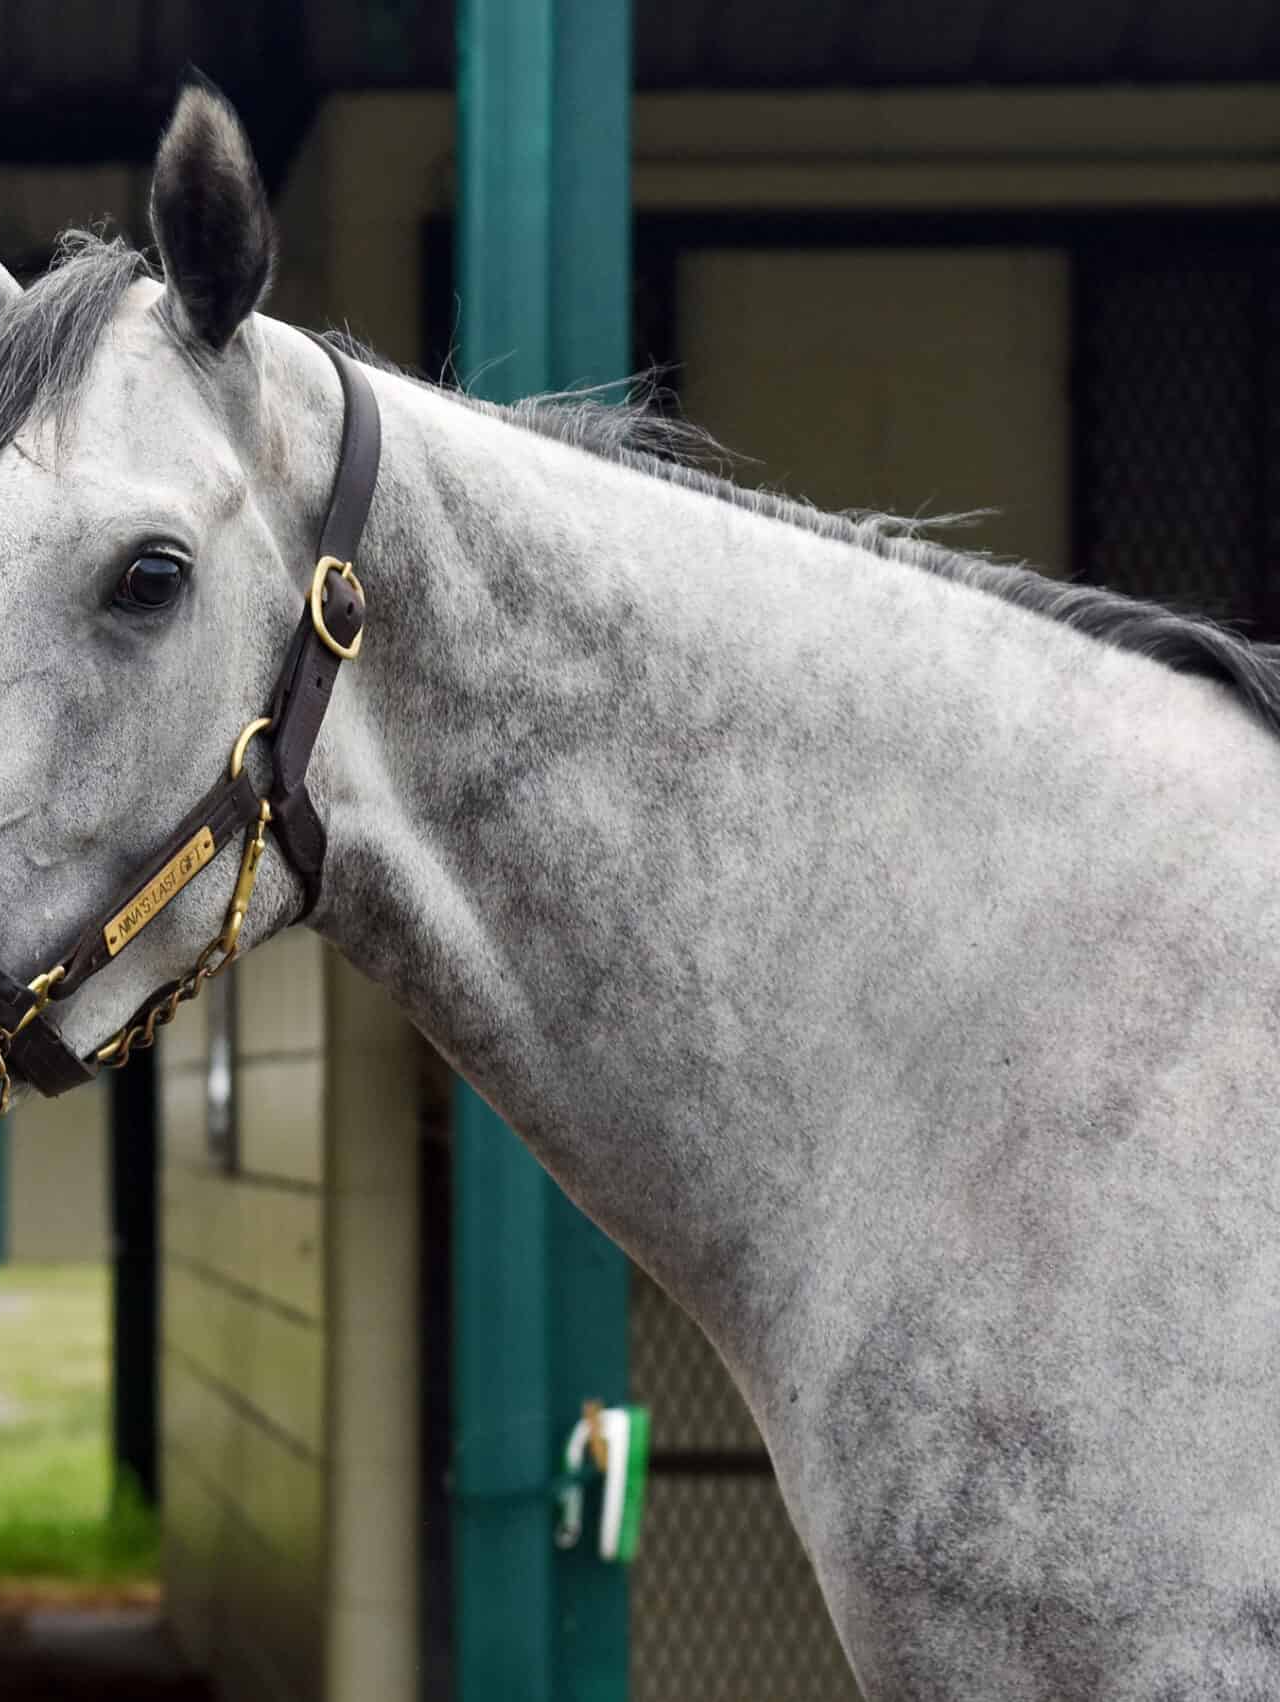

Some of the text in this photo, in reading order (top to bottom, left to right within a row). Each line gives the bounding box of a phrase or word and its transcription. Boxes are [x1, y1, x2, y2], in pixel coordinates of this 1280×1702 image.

[117, 846, 203, 937] NINA'S LAST GIFT
